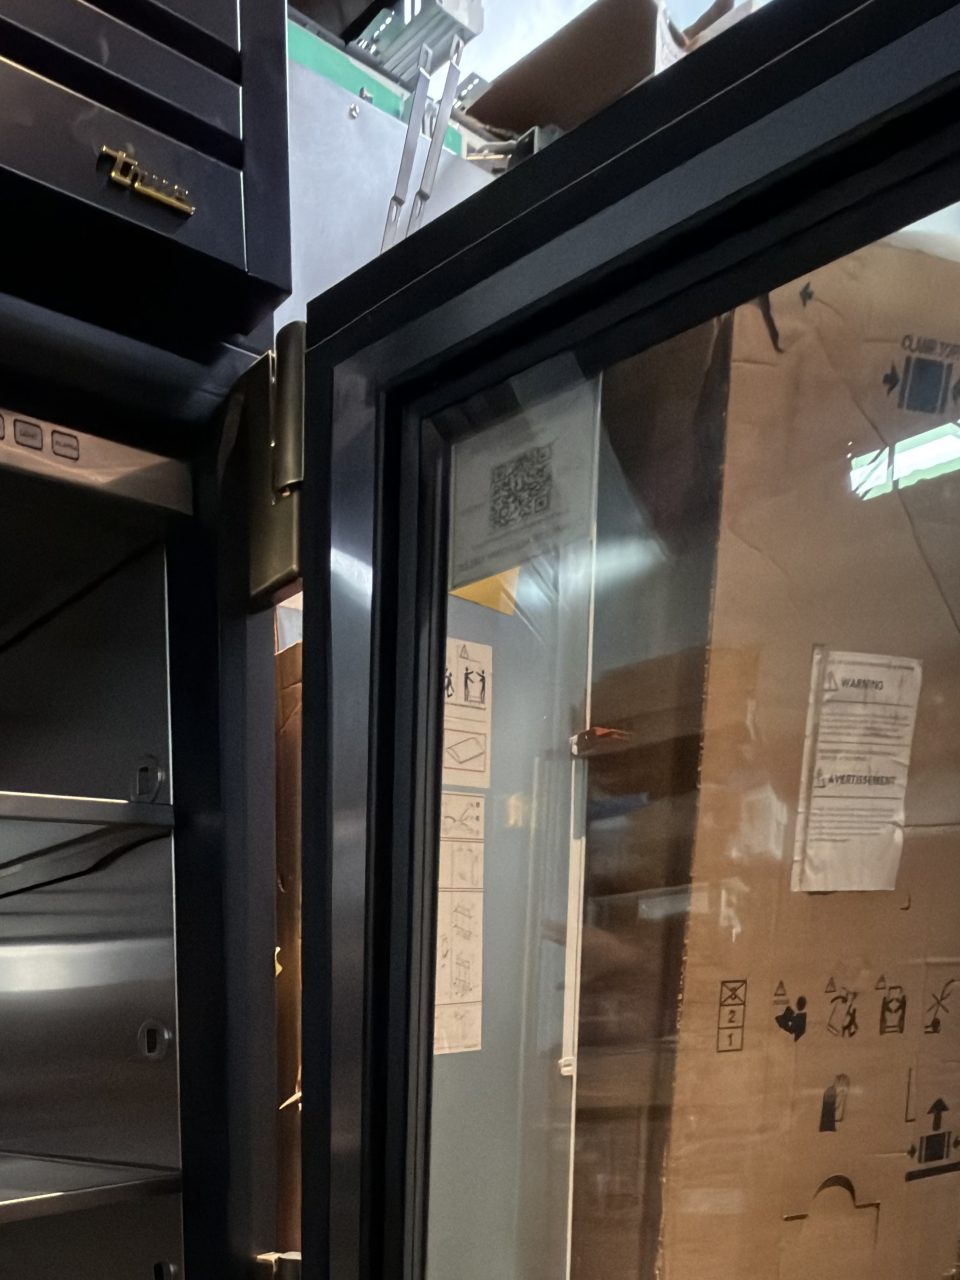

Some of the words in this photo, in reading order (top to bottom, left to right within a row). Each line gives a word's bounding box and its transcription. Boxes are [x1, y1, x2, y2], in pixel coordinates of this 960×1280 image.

[841, 678, 884, 691] WARNING
[828, 773, 897, 786] AVERTISSEMENT
[728, 1009, 736, 1023] 2
[728, 1032, 733, 1046] 1
